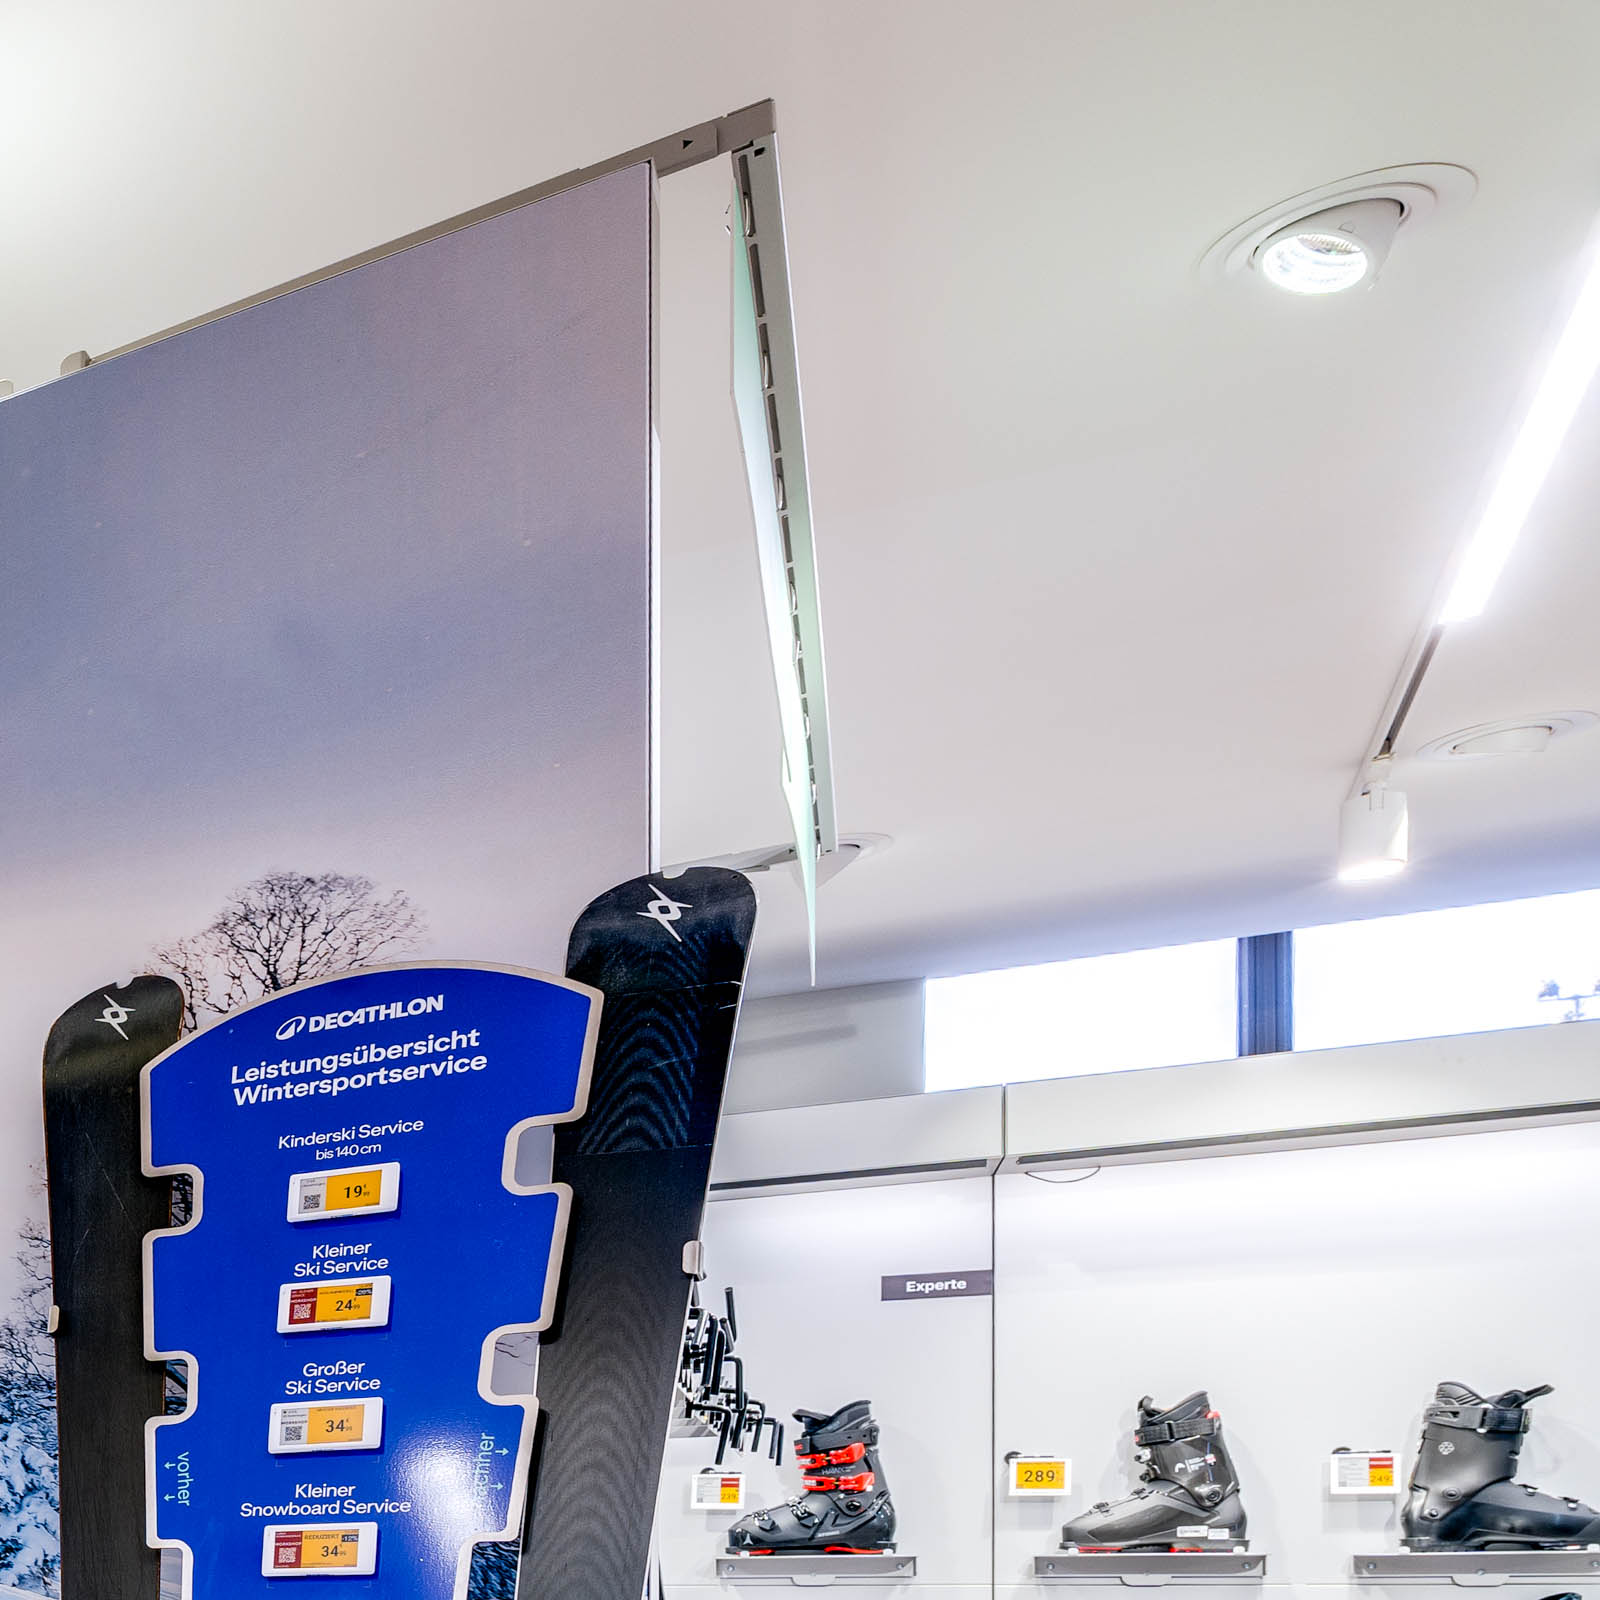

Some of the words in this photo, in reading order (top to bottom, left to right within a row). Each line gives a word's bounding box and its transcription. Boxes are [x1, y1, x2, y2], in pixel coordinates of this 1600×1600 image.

[309, 994, 444, 1033] DECATHLON
[231, 1028, 480, 1085] Leistungsübersicht
[233, 1052, 488, 1106] Wintersportservice
[278, 1126, 356, 1150] Kinderski
[358, 1118, 425, 1139] Service
[315, 1147, 334, 1161] bis
[335, 1145, 358, 1158] 140
[360, 1145, 382, 1155] cm
[313, 1242, 372, 1259] Kleiner
[294, 1260, 320, 1277] Ski
[322, 1256, 389, 1276] Service
[905, 1277, 967, 1294] Experte
[303, 1361, 365, 1378] Großer
[285, 1379, 312, 1395] Ski
[315, 1377, 381, 1394] Service
[325, 1419, 345, 1433] 34
[177, 1452, 190, 1507] vorher
[1024, 1470, 1055, 1483] 289
[295, 1483, 355, 1499] Kleiner
[240, 1500, 339, 1518] Snowboard
[343, 1498, 411, 1515] Service
[321, 1545, 338, 1557] 34
